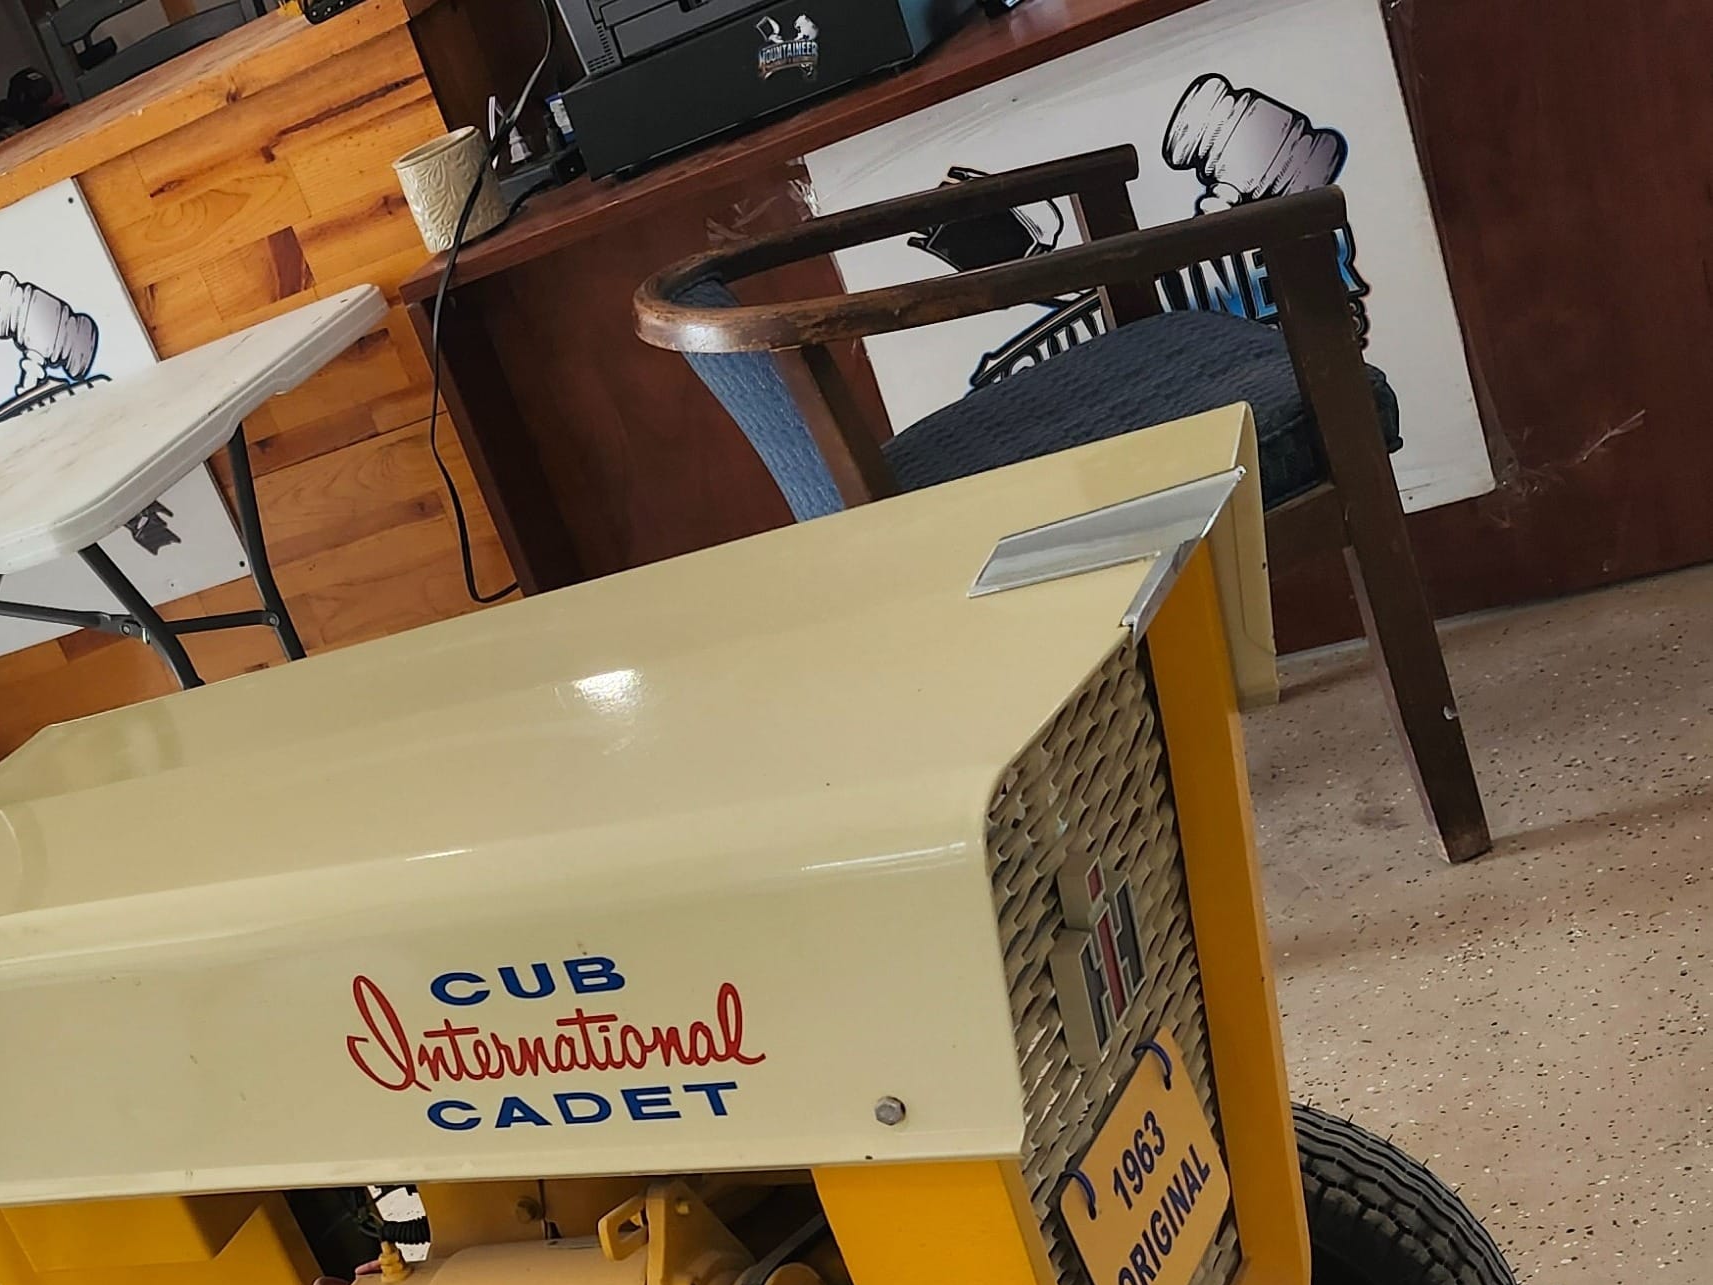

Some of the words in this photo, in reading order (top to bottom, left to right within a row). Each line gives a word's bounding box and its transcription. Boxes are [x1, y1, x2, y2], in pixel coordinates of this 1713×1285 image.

[759, 42, 817, 68] MOUNTAINEER
[430, 955, 626, 1006] CUB
[346, 974, 766, 1092] International
[426, 1081, 739, 1131] CADET
[1112, 1108, 1166, 1212] 1963
